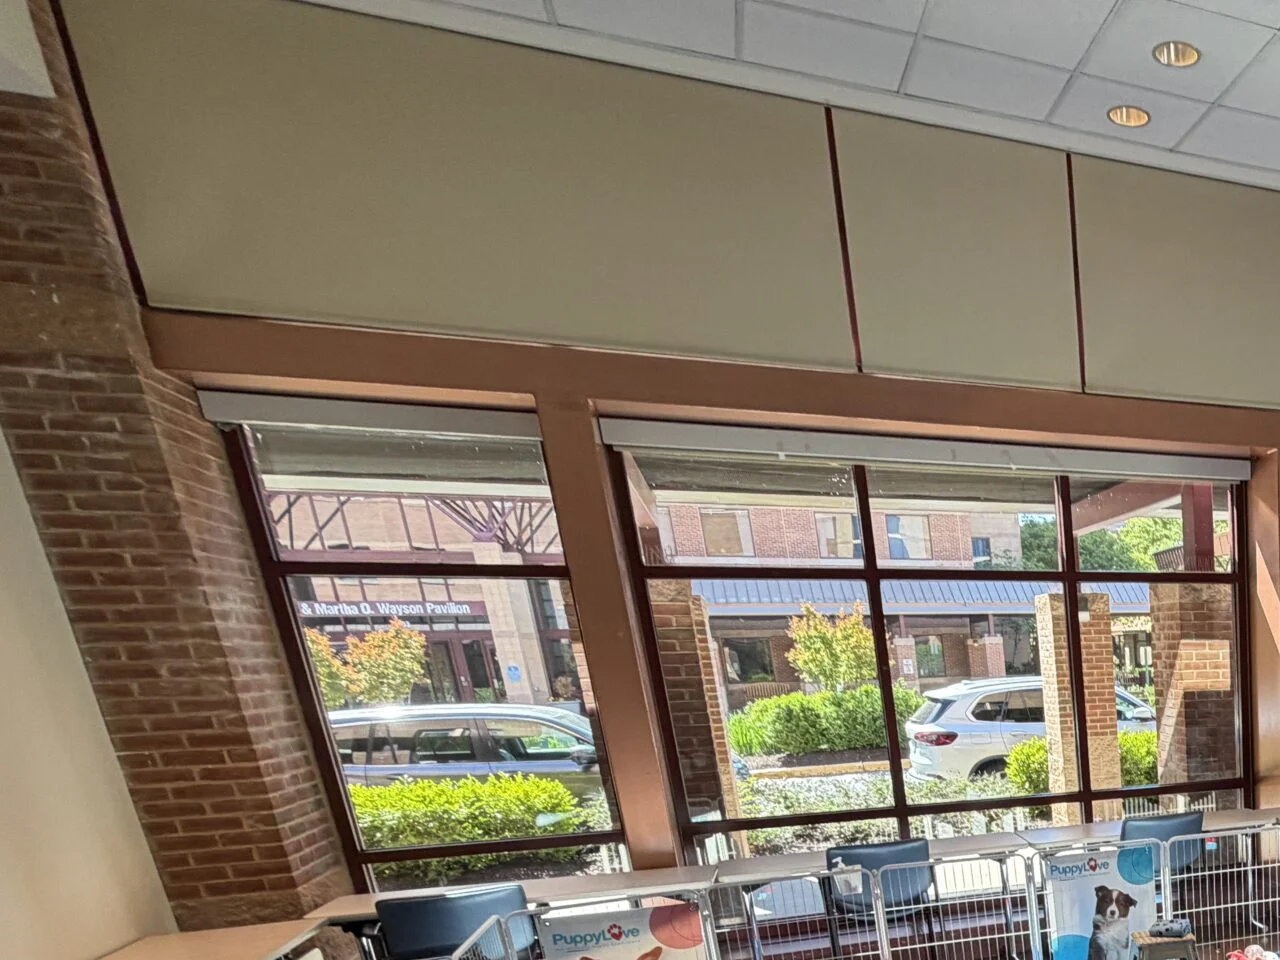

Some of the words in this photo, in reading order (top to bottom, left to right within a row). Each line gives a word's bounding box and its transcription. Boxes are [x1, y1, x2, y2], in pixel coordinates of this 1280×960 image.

[301, 603, 312, 614] &
[314, 603, 358, 614] Martha
[377, 603, 424, 616] Wayson
[426, 603, 471, 614] Pavilion
